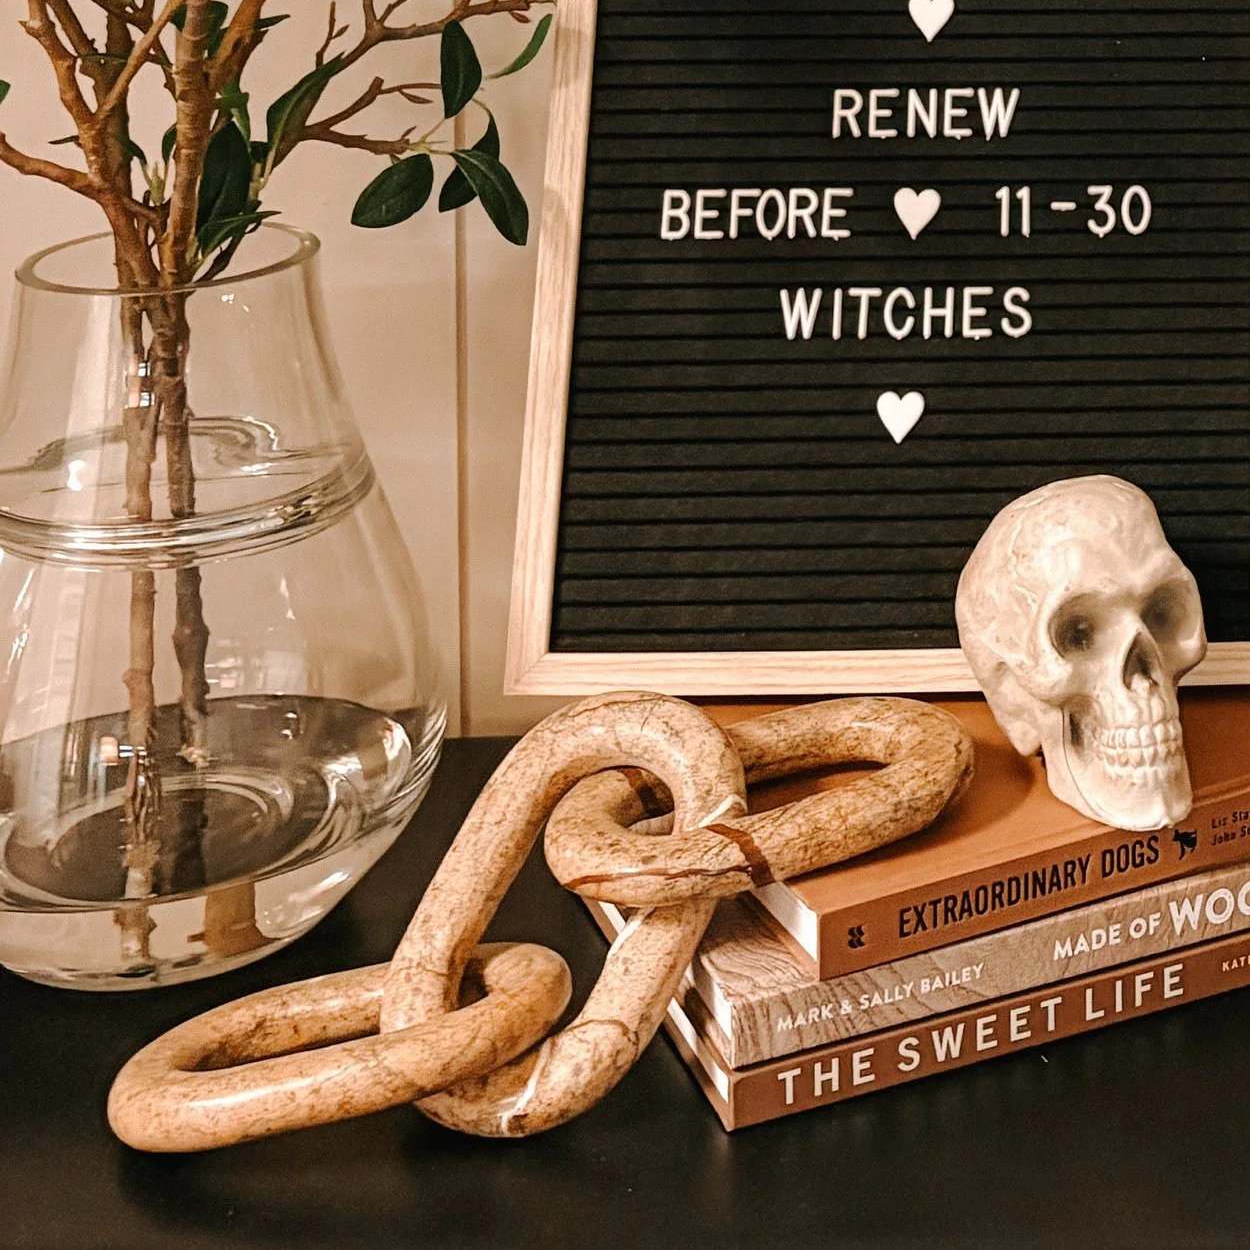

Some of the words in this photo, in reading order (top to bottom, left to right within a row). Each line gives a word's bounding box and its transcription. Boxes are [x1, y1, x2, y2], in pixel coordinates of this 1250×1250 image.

[832, 87, 1019, 141] RENEW
[660, 187, 853, 240] BEFORE
[780, 287, 1033, 340] WITCHES
[1211, 817, 1227, 830] Liz
[1211, 832, 1236, 846] John
[899, 854, 1091, 938] EXTRAORDINARY
[1101, 836, 1160, 879] DOGS
[1053, 923, 1121, 961] MADE
[1129, 912, 1161, 939] OF
[777, 1003, 834, 1034] MARK
[839, 999, 852, 1015] &
[858, 981, 914, 1010] SALLY
[920, 962, 985, 995] BAILEY
[777, 1047, 876, 1105] THE
[897, 997, 1062, 1072] SWEET
[1085, 963, 1184, 1023] LIFE
